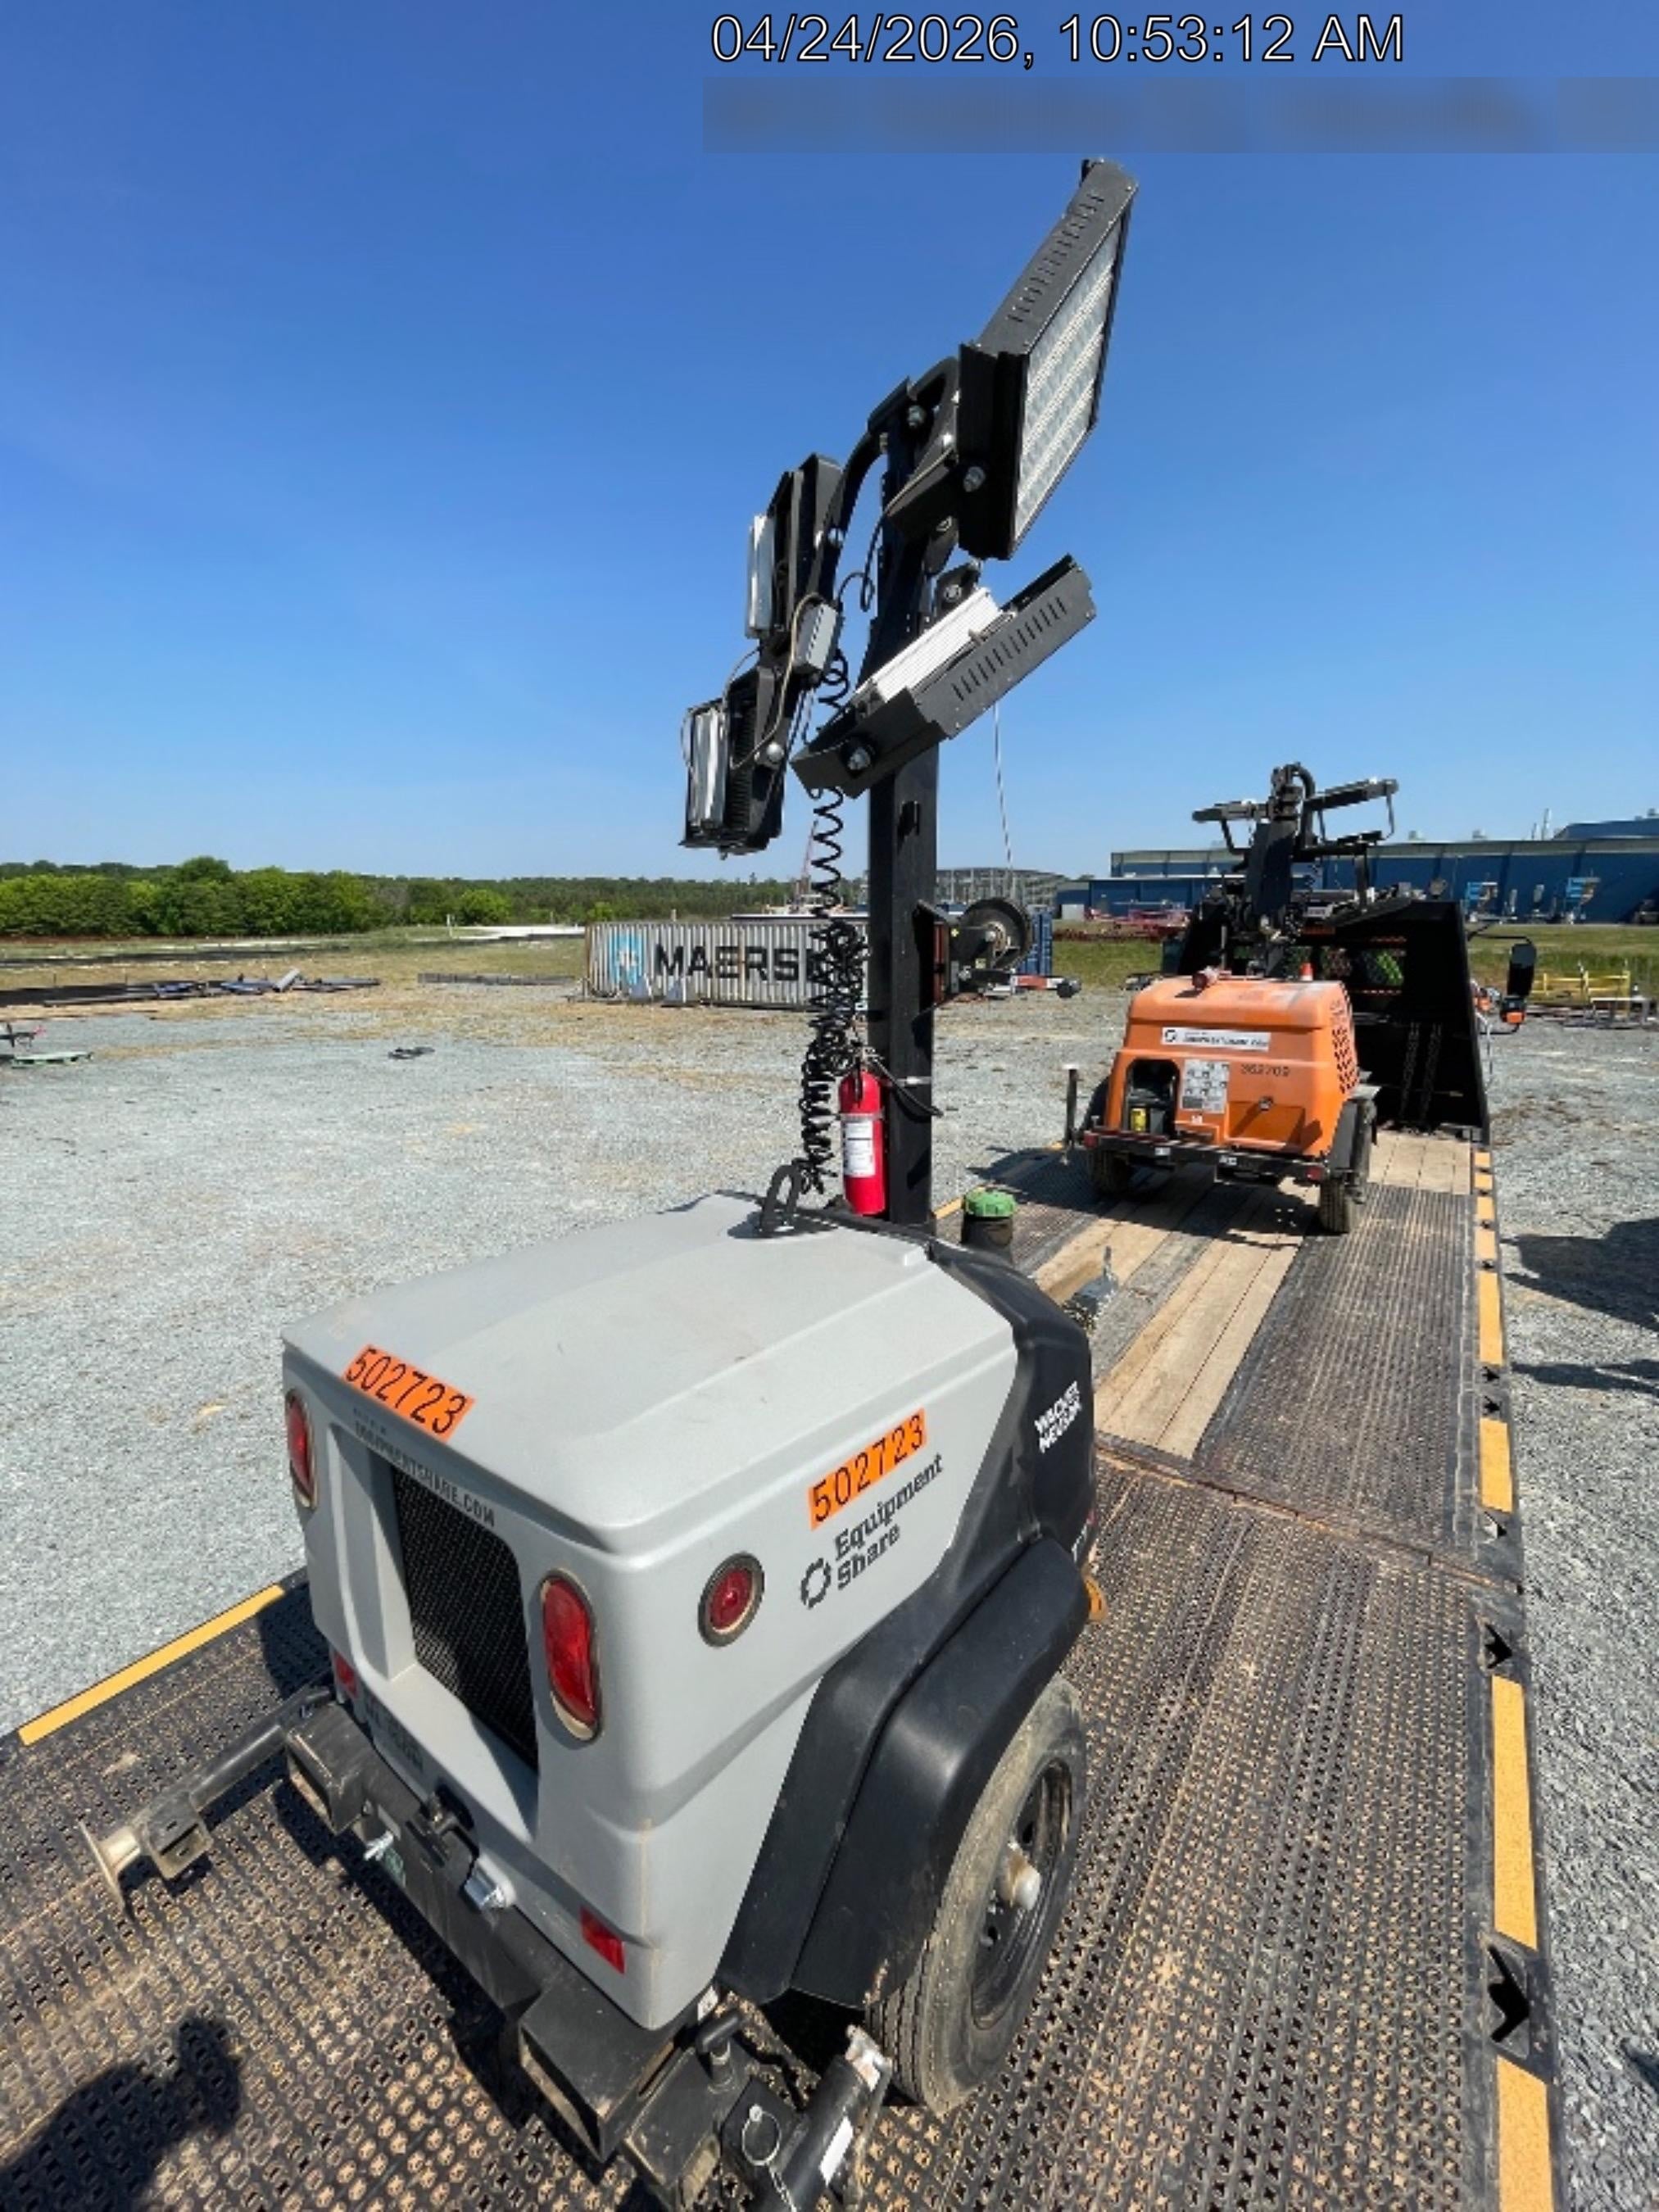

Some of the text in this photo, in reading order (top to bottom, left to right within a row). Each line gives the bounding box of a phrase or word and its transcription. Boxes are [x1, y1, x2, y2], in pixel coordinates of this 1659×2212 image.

[346, 1348, 468, 1435] 502723
[814, 1413, 925, 1523] 502723
[834, 1453, 943, 1562] Equipment
[837, 1525, 900, 1590] Share
